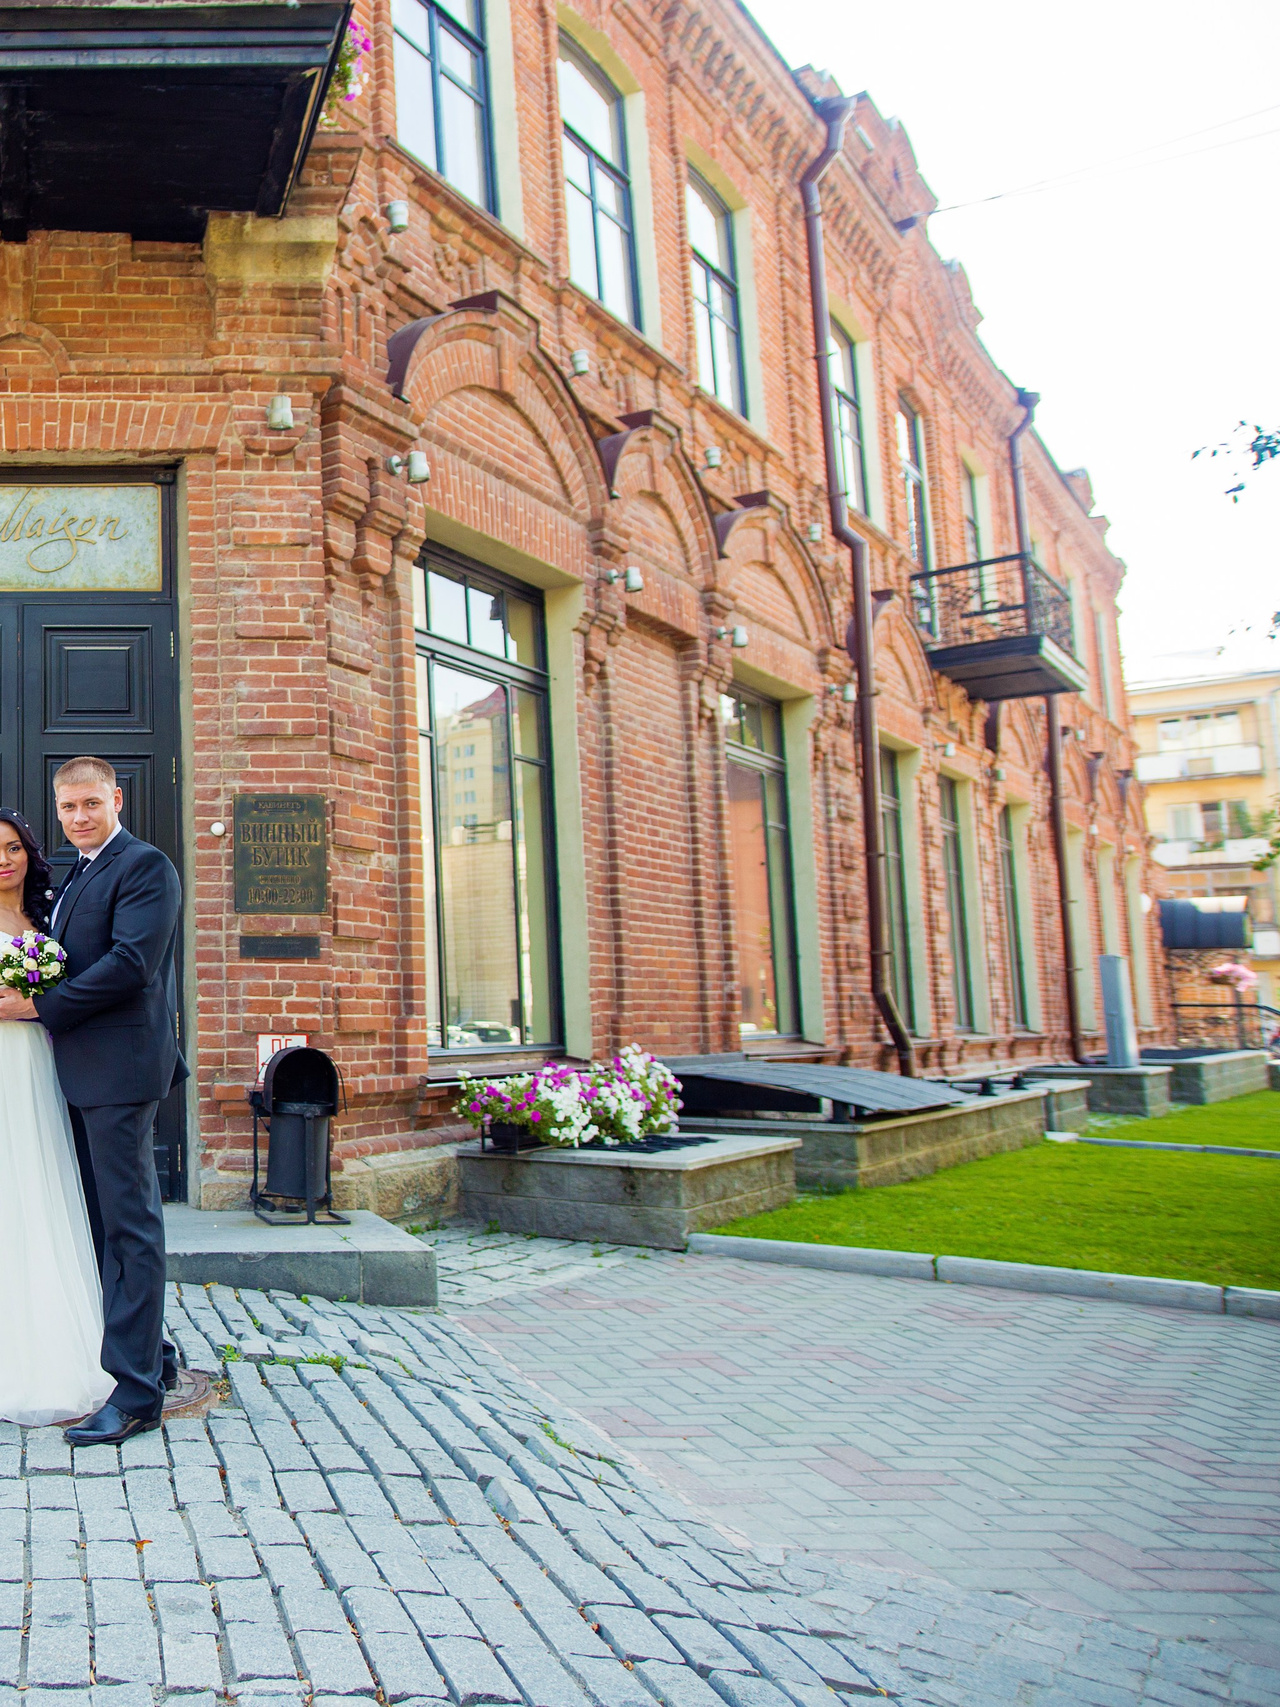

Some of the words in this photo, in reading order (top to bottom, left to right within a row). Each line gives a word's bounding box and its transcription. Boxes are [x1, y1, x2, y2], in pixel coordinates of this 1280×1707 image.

[240, 818, 320, 844] ВИННЫЙ
[251, 846, 310, 866] БУТИК
[247, 887, 314, 905] 10:00-22:00
